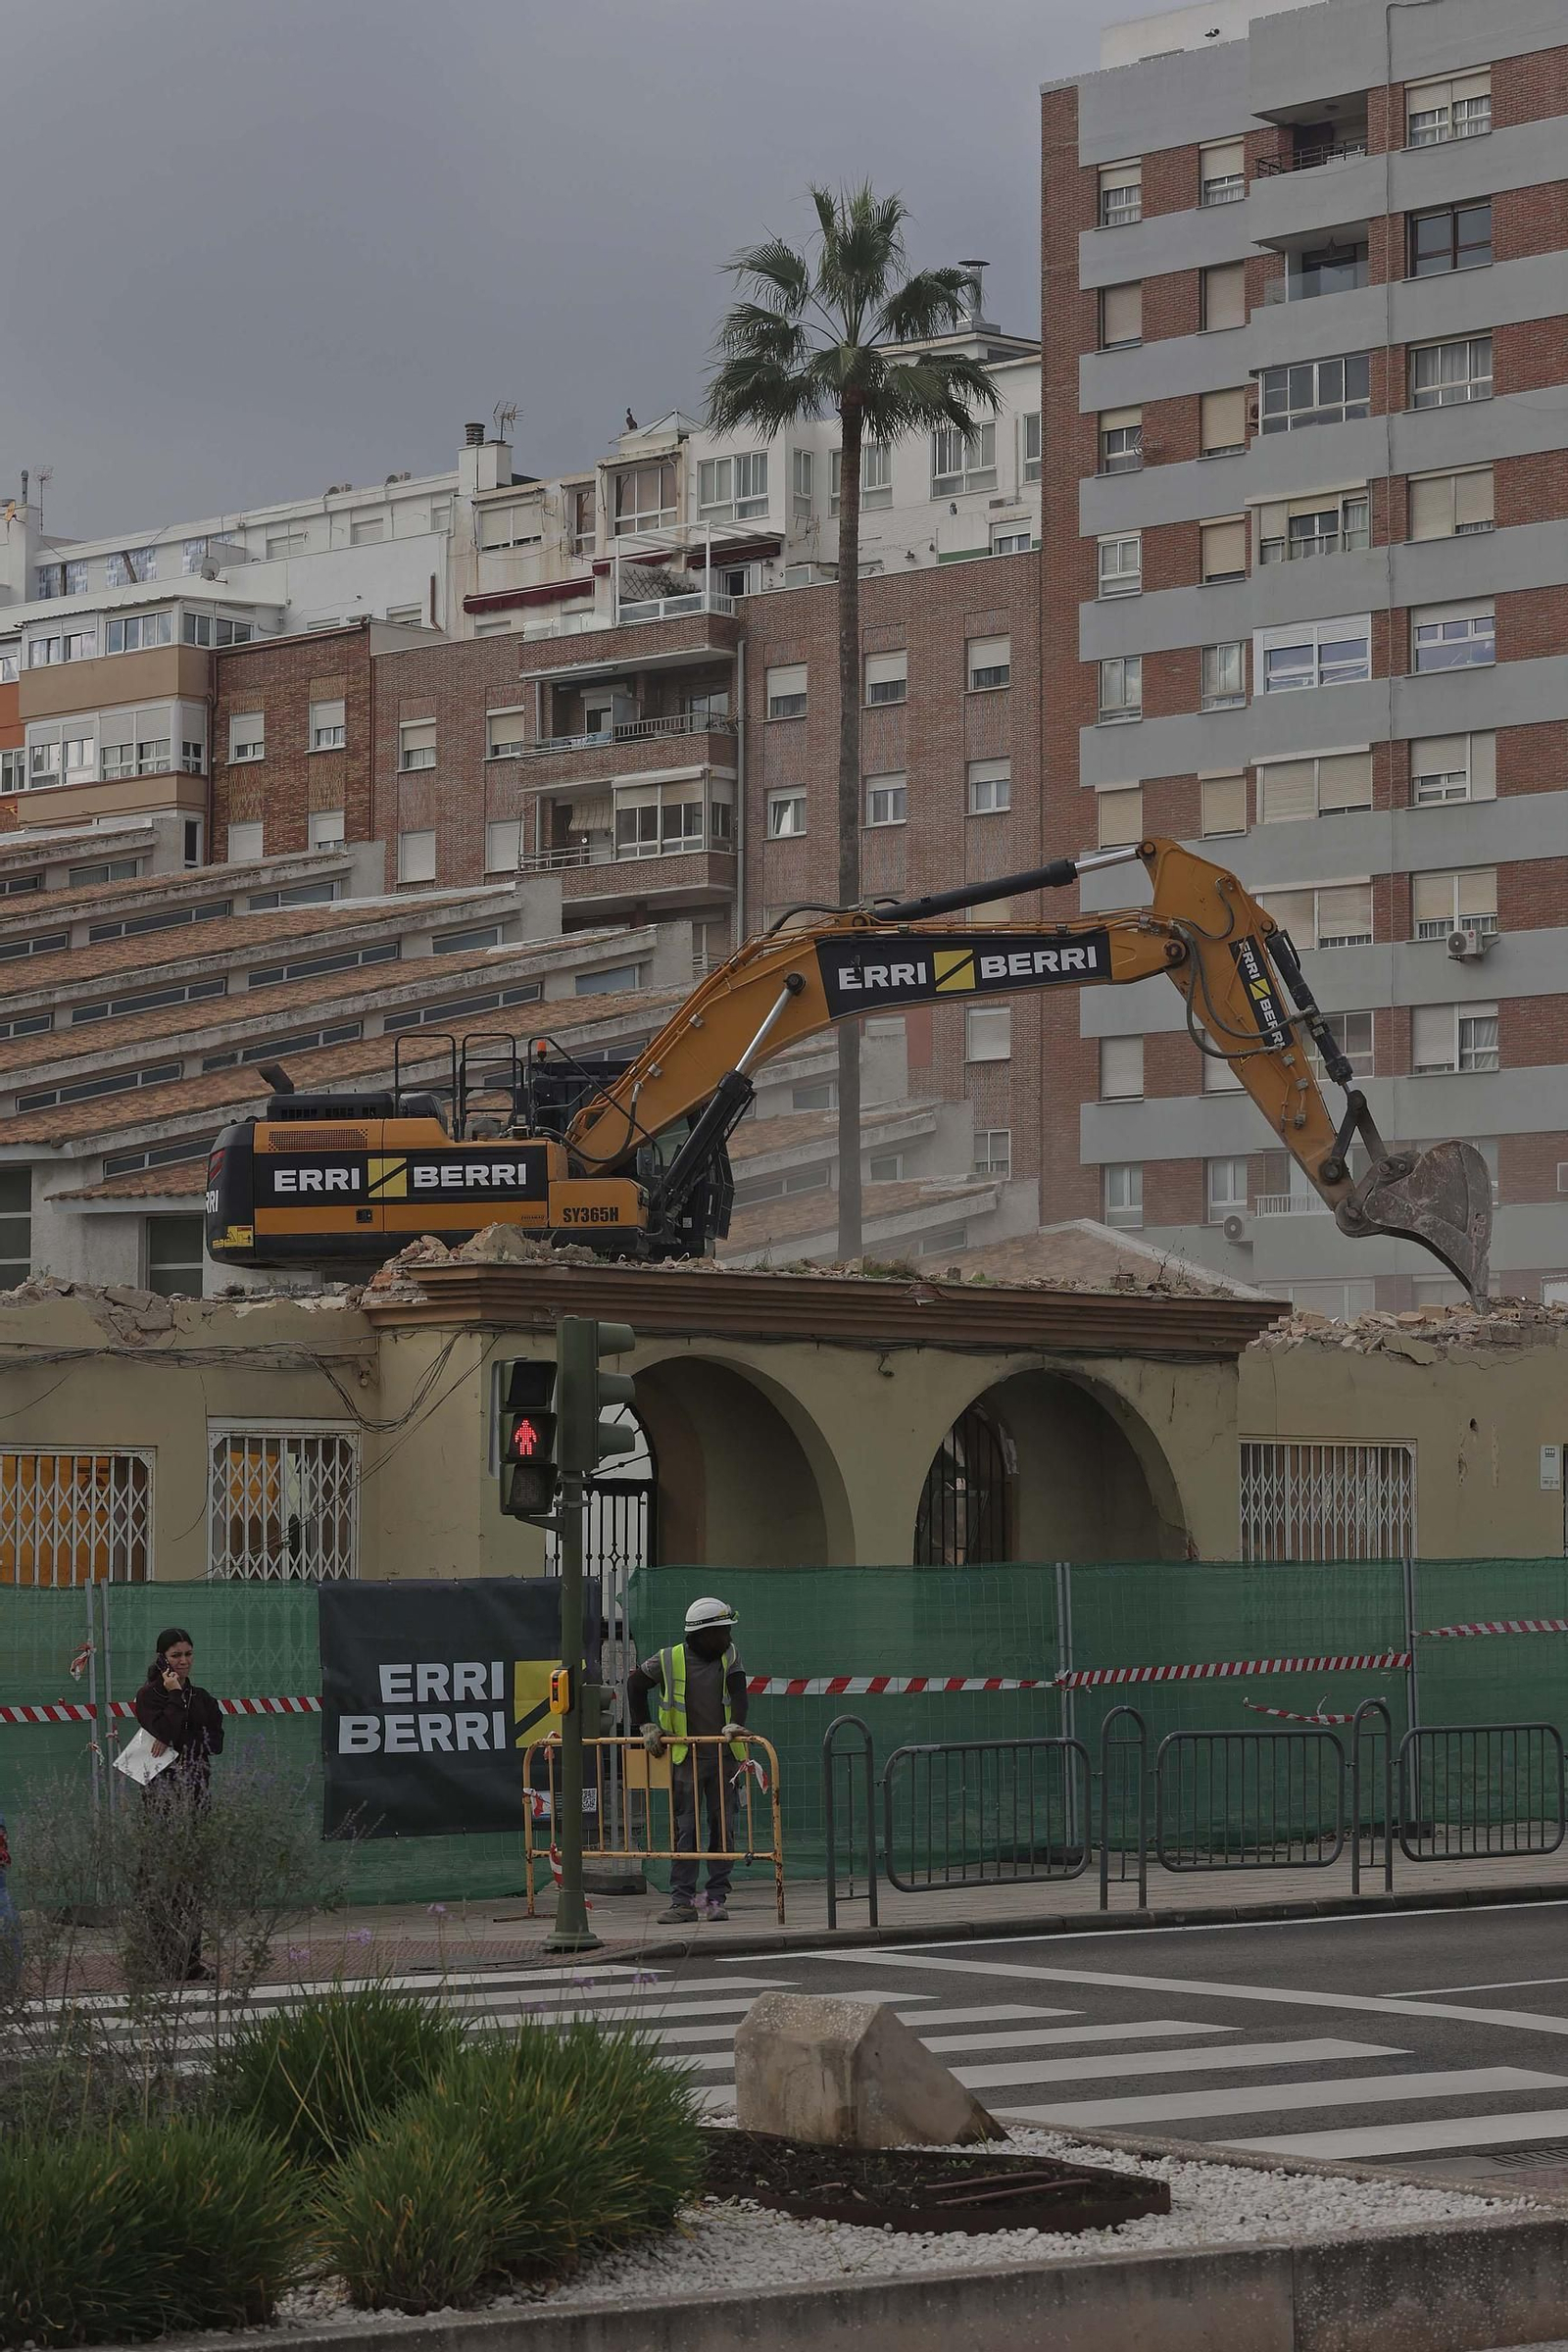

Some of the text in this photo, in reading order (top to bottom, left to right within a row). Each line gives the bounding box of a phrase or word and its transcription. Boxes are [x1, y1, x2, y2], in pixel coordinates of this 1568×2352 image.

[838, 946, 1098, 990] ERRI BERRI
[1239, 941, 1260, 979] ERRI
[274, 1163, 526, 1192] ERRI BERRI
[563, 1206, 618, 1222] SY365H
[378, 1661, 505, 1703] ERRI
[338, 1711, 507, 1754] BERRI
